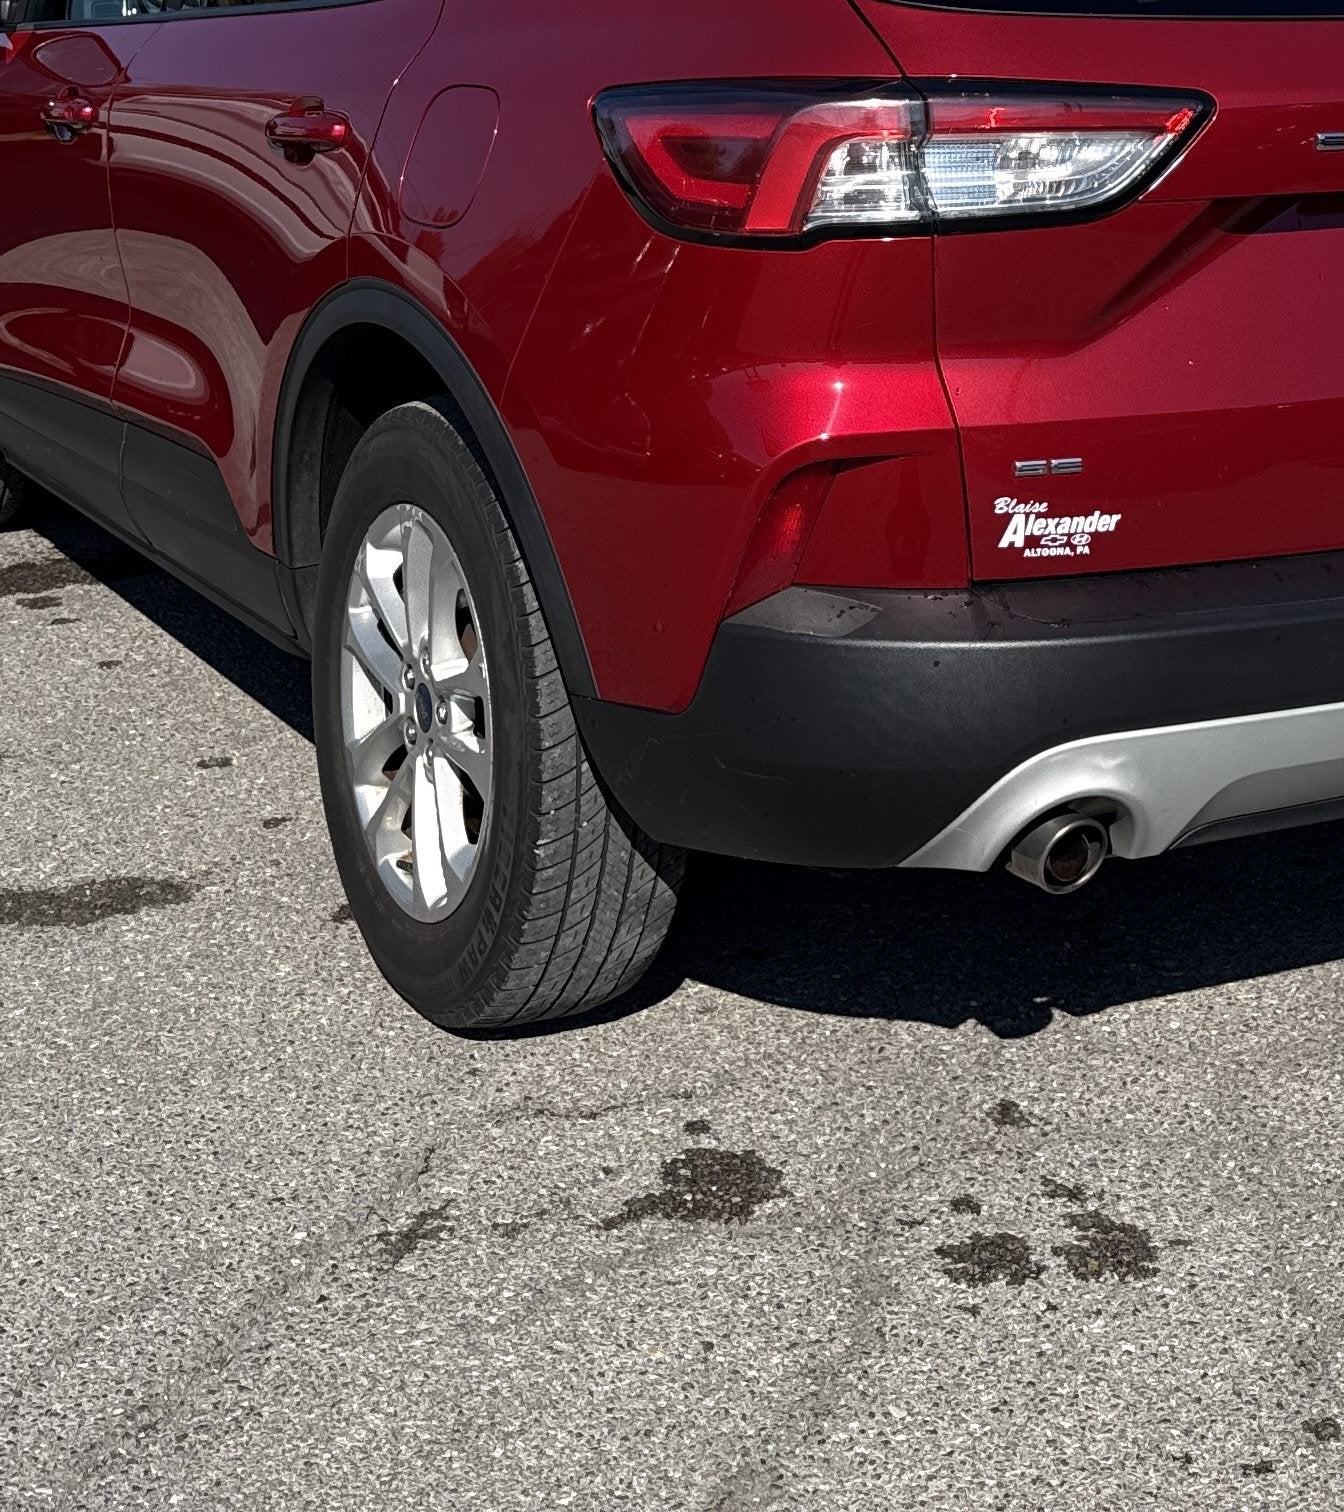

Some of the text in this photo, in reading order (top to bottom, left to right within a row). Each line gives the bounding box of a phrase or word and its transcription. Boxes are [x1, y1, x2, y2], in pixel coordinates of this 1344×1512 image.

[1013, 456, 1084, 478] SE
[993, 496, 1049, 515] Blaise
[997, 510, 1123, 548] Alexander
[1023, 544, 1091, 558] ALTOONA, PA
